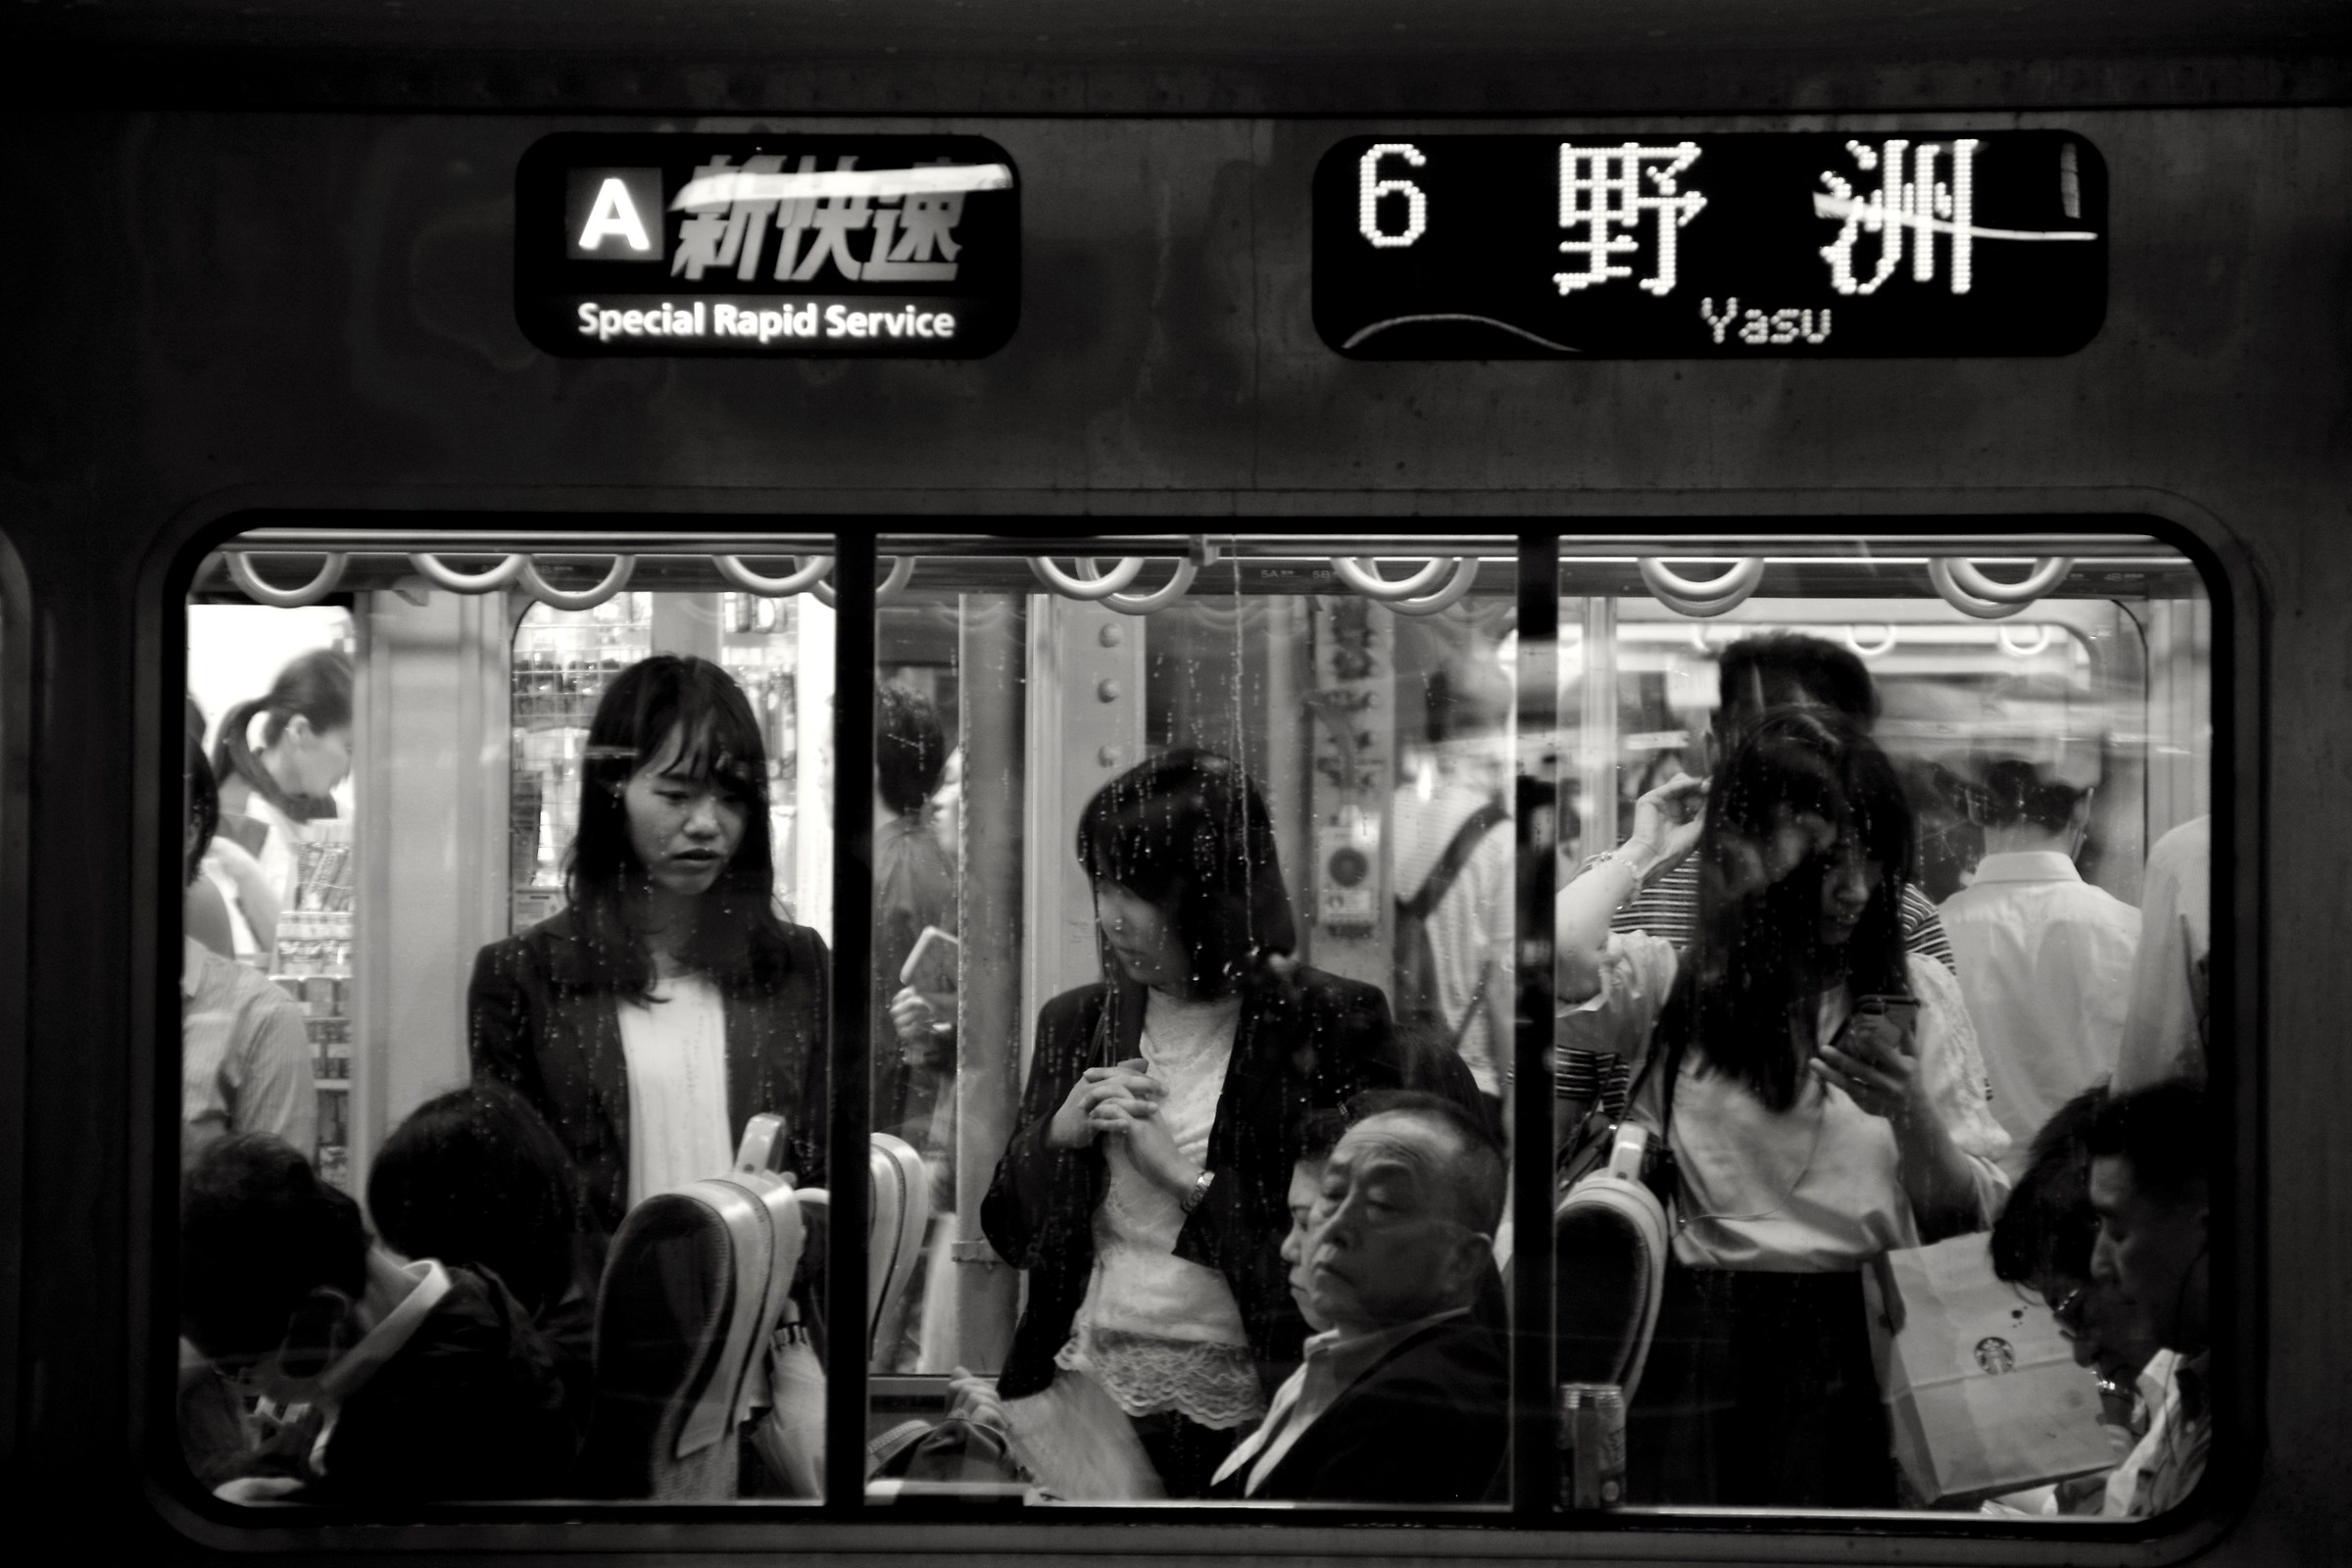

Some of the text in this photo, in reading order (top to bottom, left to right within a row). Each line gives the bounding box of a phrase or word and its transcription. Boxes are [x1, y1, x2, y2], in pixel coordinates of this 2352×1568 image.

[578, 177, 652, 252] A
[670, 154, 969, 282] 新快速
[1358, 143, 1427, 249] 6
[1551, 138, 1981, 295] 野洲
[577, 300, 956, 344] Special Rapid Service
[1700, 297, 1833, 344] Yasu
